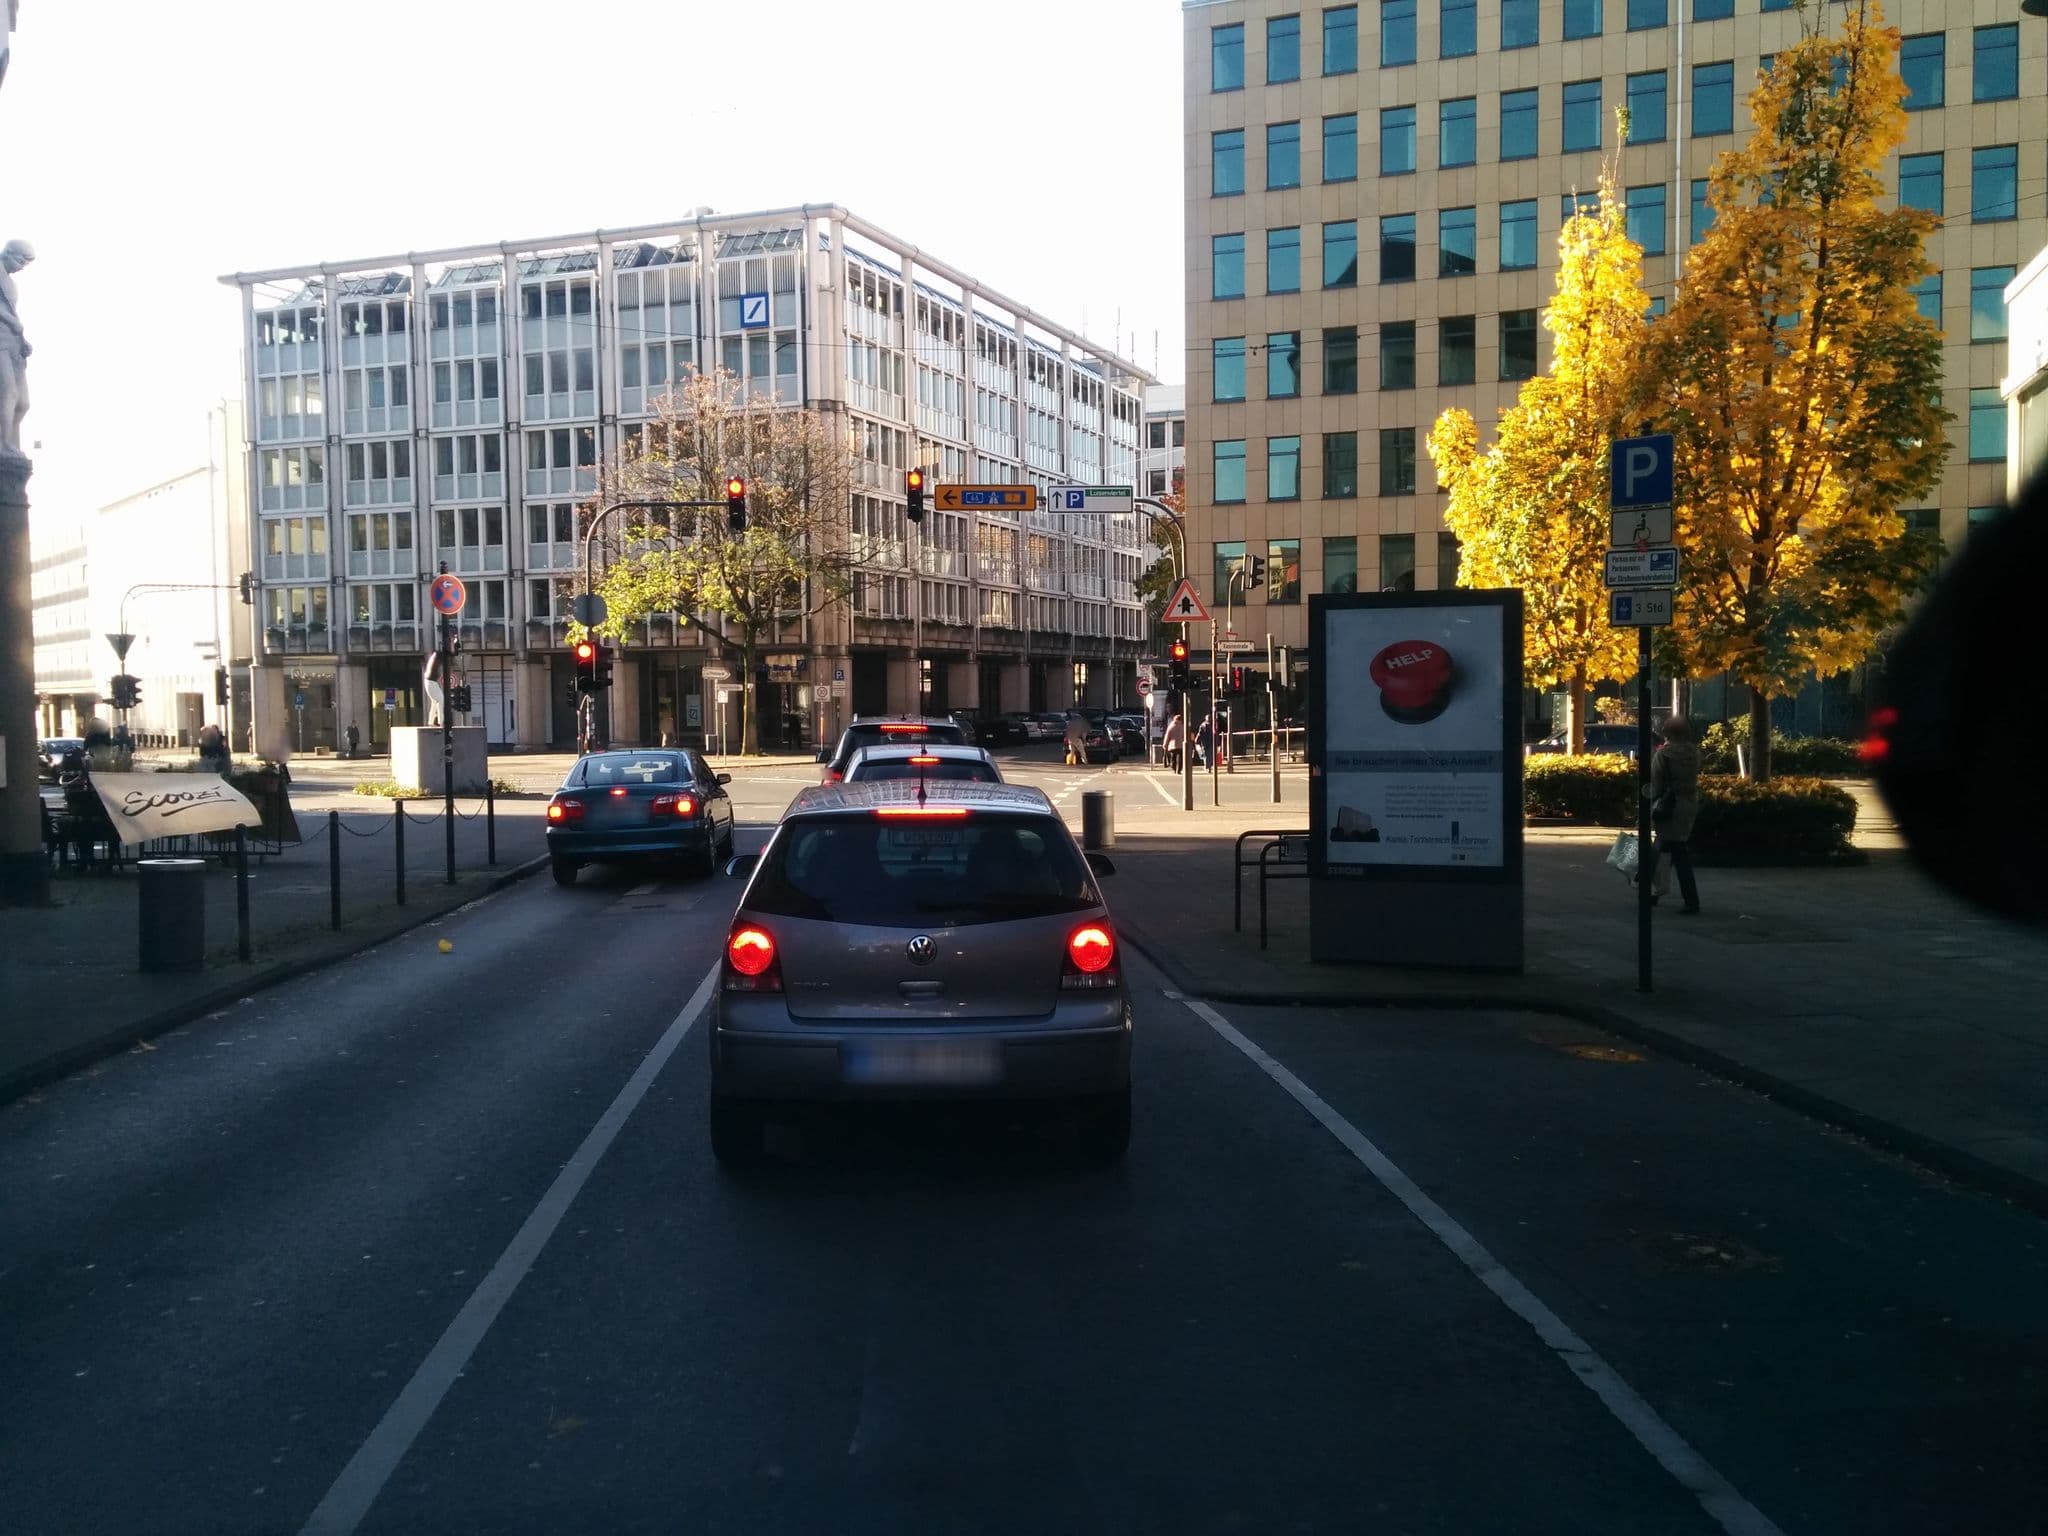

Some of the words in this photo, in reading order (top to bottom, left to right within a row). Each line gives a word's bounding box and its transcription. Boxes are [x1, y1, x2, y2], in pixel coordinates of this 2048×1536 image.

[1626, 447, 1658, 498] P
[1070, 492, 1080, 506] P
[1090, 489, 1127, 497] Luisenviertel
[1636, 604, 1642, 613] 3
[1647, 603, 1663, 612] Std
[1386, 648, 1434, 670] HELP
[836, 671, 843, 680] P
